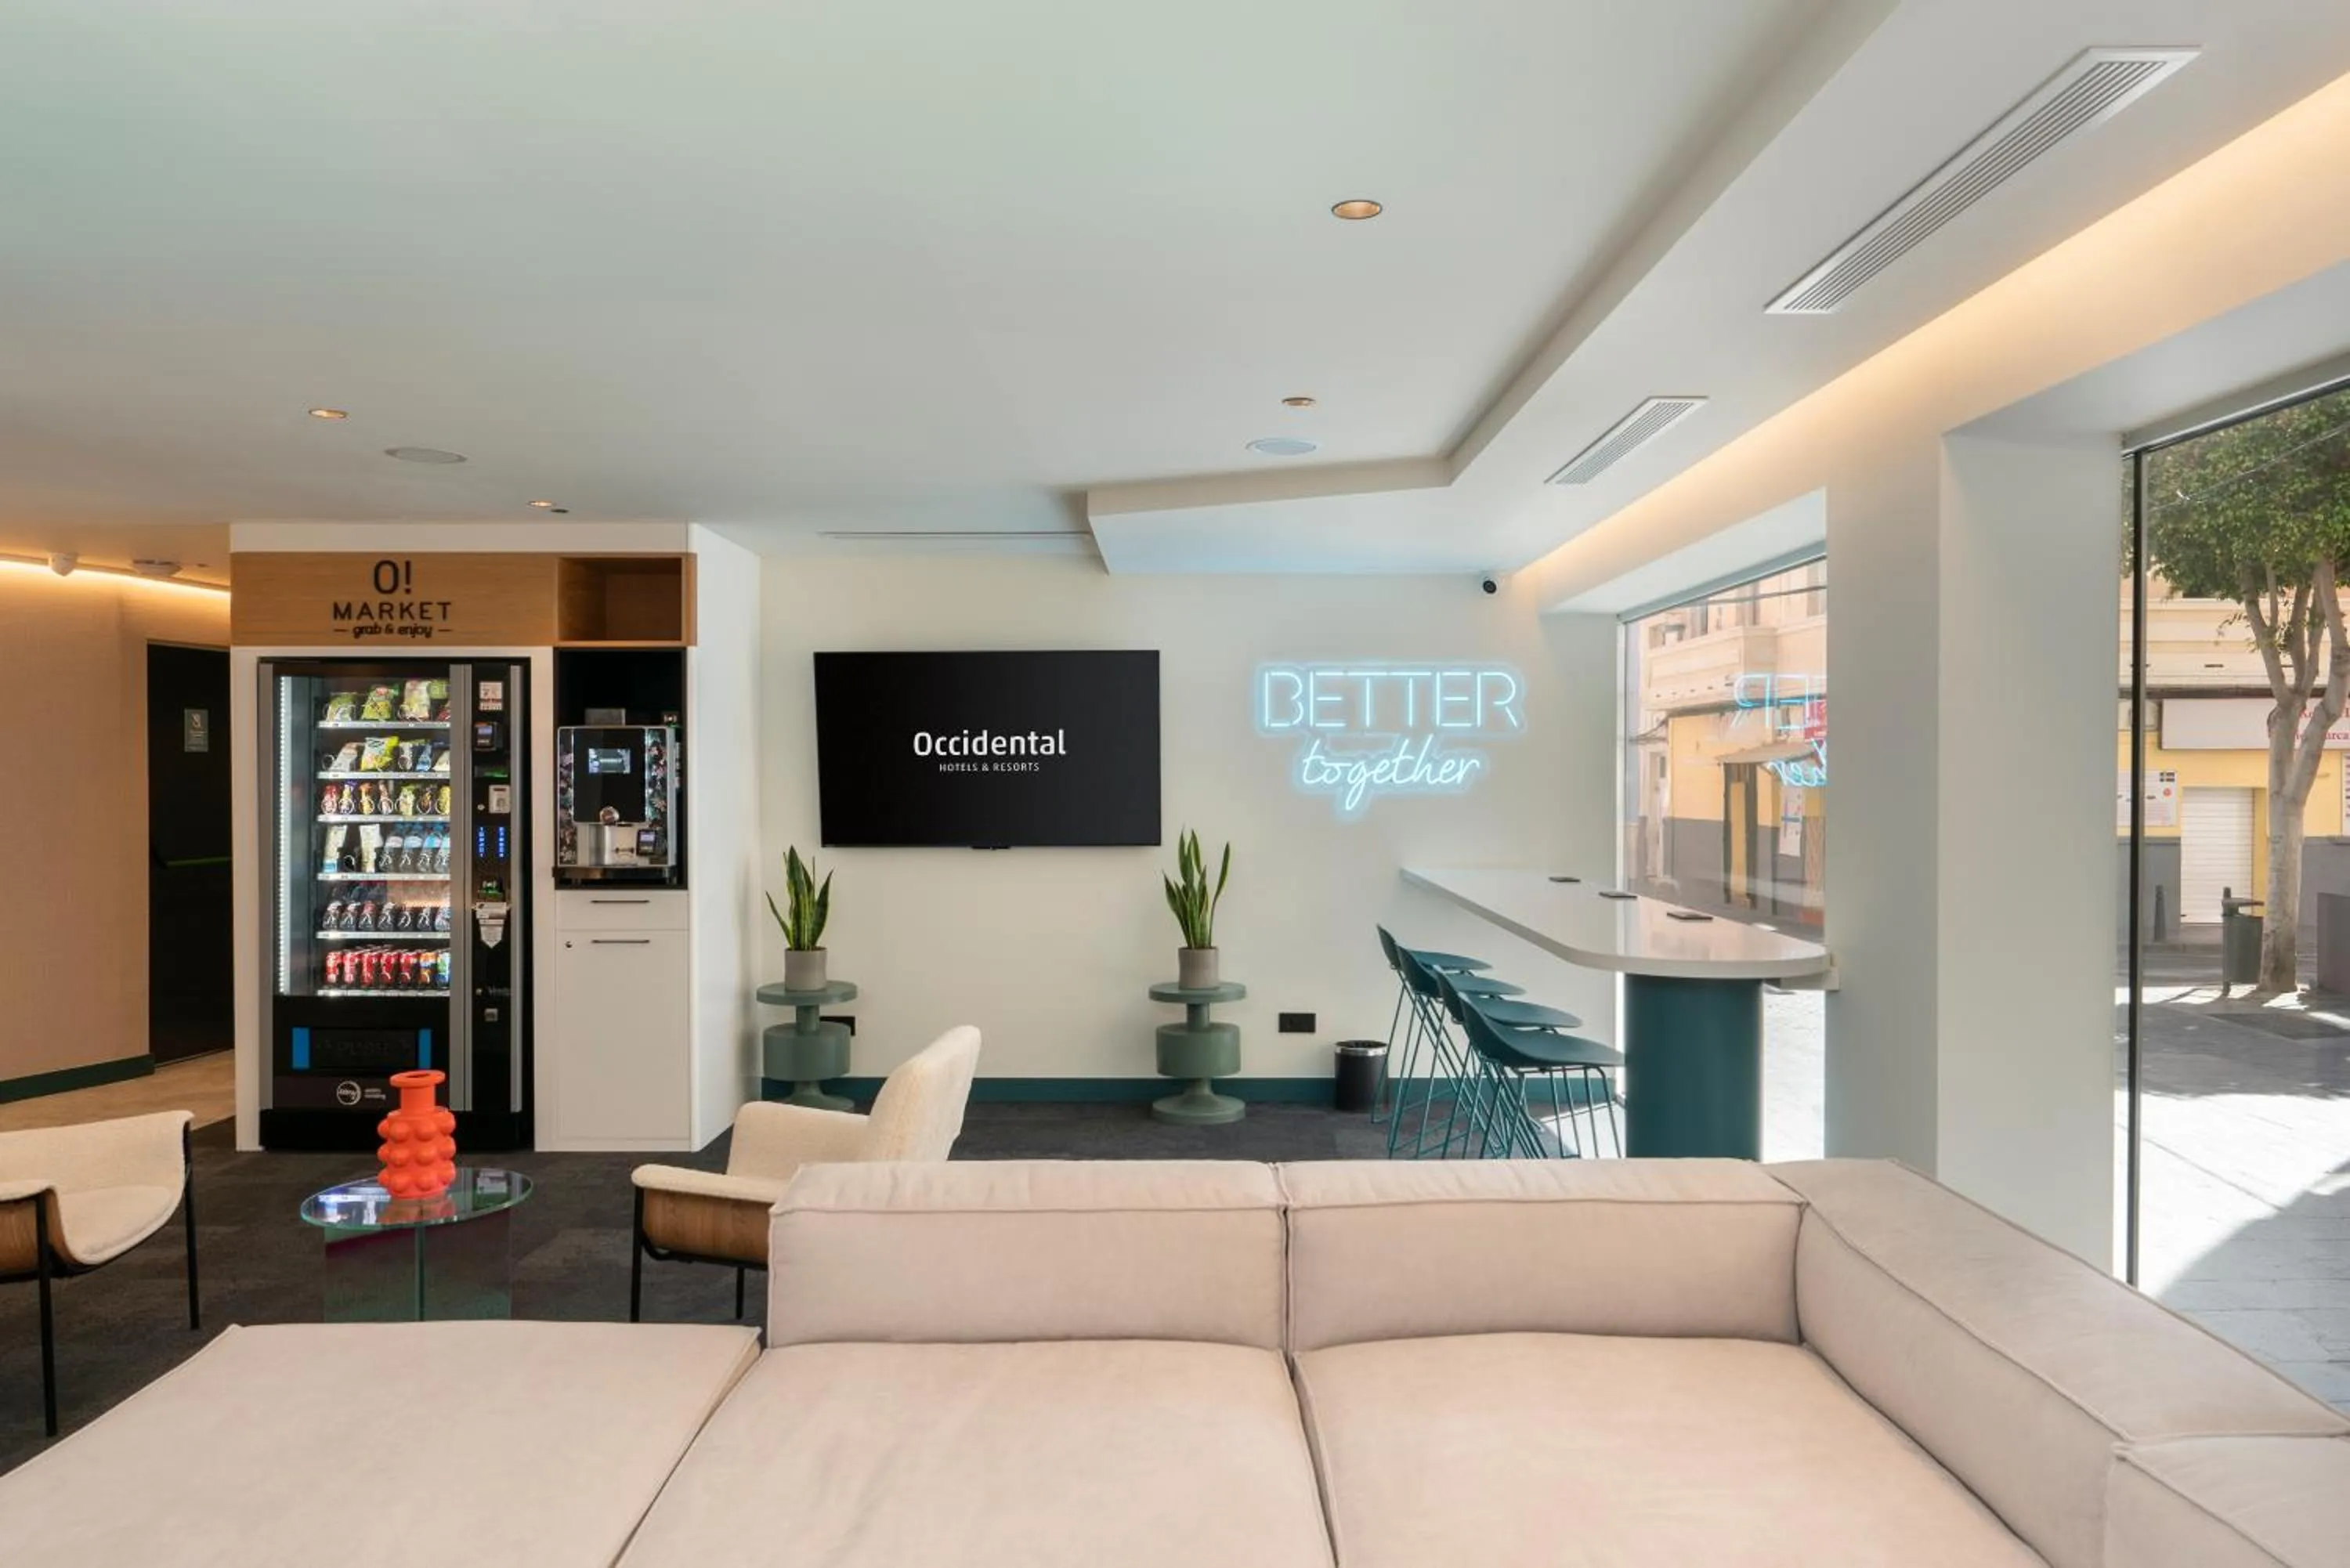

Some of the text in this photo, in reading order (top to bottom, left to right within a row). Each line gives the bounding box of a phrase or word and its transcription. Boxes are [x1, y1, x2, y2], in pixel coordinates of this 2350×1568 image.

[373, 559, 412, 594] O!
[332, 601, 452, 621] MARKET
[352, 622, 432, 639] grab & enjoy
[1263, 670, 1519, 728] BETTER
[913, 728, 1067, 756] Occidental
[939, 762, 1040, 772] HOTELS & RESORTS
[1301, 733, 1480, 811] together
